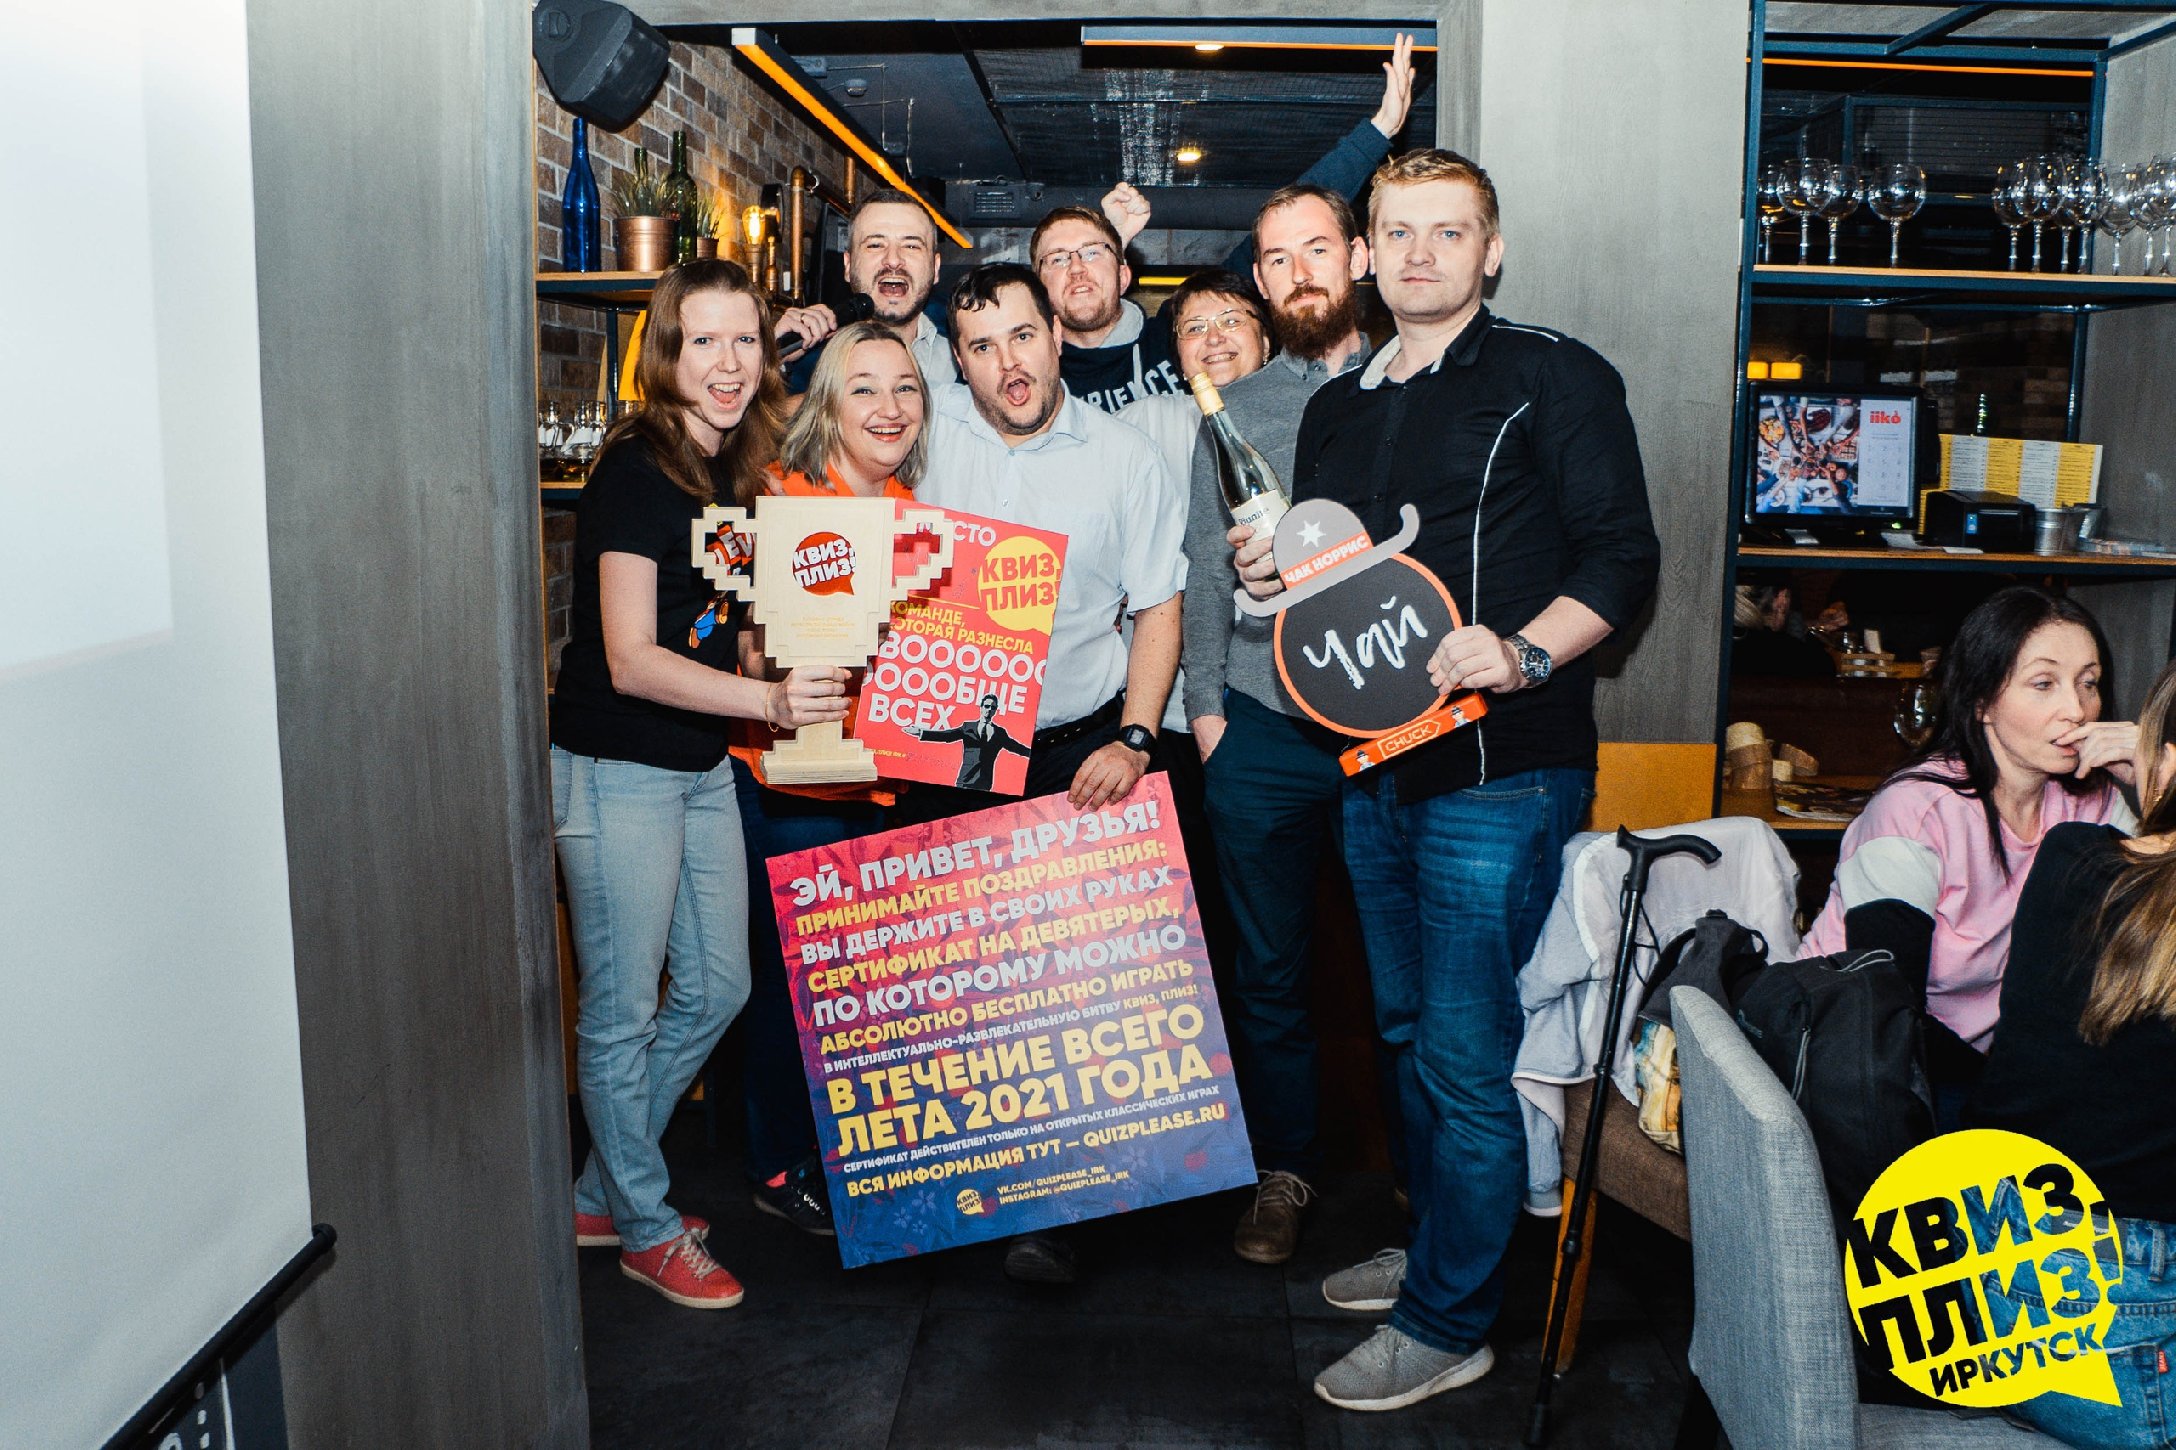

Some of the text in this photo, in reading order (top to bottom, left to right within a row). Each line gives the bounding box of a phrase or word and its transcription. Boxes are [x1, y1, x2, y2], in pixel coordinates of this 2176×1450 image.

[1084, 360, 1184, 415] RIENCE
[794, 539, 856, 570] КВИЗ,
[794, 554, 857, 588] ПЛИЗ!
[983, 552, 1062, 583] КВИЗ,
[1283, 535, 1368, 583] ЧАК НОРРИС
[891, 615, 1034, 655] ОТОРАЯ РАЗНЕСЛА
[868, 693, 956, 731] ВСЕХ
[1385, 725, 1433, 751] CHUCK
[790, 800, 1160, 907] ЭЙ, ПРИВЕТ, ДРУЗЬЯ!
[796, 839, 1169, 937] ПРИНИМАЙТЕ ПОЗДРАВЛЕНИЯ:
[801, 865, 1174, 965] ВЫ ДЕРЖИТЕ В СВОИХ РУКАХ
[808, 897, 1180, 993] СЕРТИФИКАТ НА ДЕВЯТЕРЫХ,
[813, 925, 1186, 1026] ПО КОТОРОМУ МОЖНО
[820, 959, 1194, 1055] АБСОЛЮТНО БЕСПЛАТНО ИГРАТЬ
[824, 984, 1198, 1073] В ИНТЕЛЛЕКТУАЛЬНО-РАЗВЛЕКАТЕЛЬНУЮ БИТВУ КВИЗ, ПЛИЗ!
[827, 1004, 1204, 1114] В ТЕЧЕНИЕ ВСЕГО
[837, 1043, 1213, 1157] ЛЕТА 2021 ГОДА
[843, 1085, 1220, 1173] СЕРТИФИКАТ ДЕЙСТВИТЕЛЕН ТОЛЬКО НА ОТКРЫТЫХ КЛАССИЧЕСКИХ ИГРАХ
[847, 1176, 884, 1197] ВСЯ
[887, 1149, 1025, 1190] ИНФОРМАЦИЯ
[1026, 1138, 1060, 1160] ТУТ
[1083, 1103, 1225, 1147] QUIZPLEASE.RU
[1000, 1188, 1052, 1205] INSTAGRAM:
